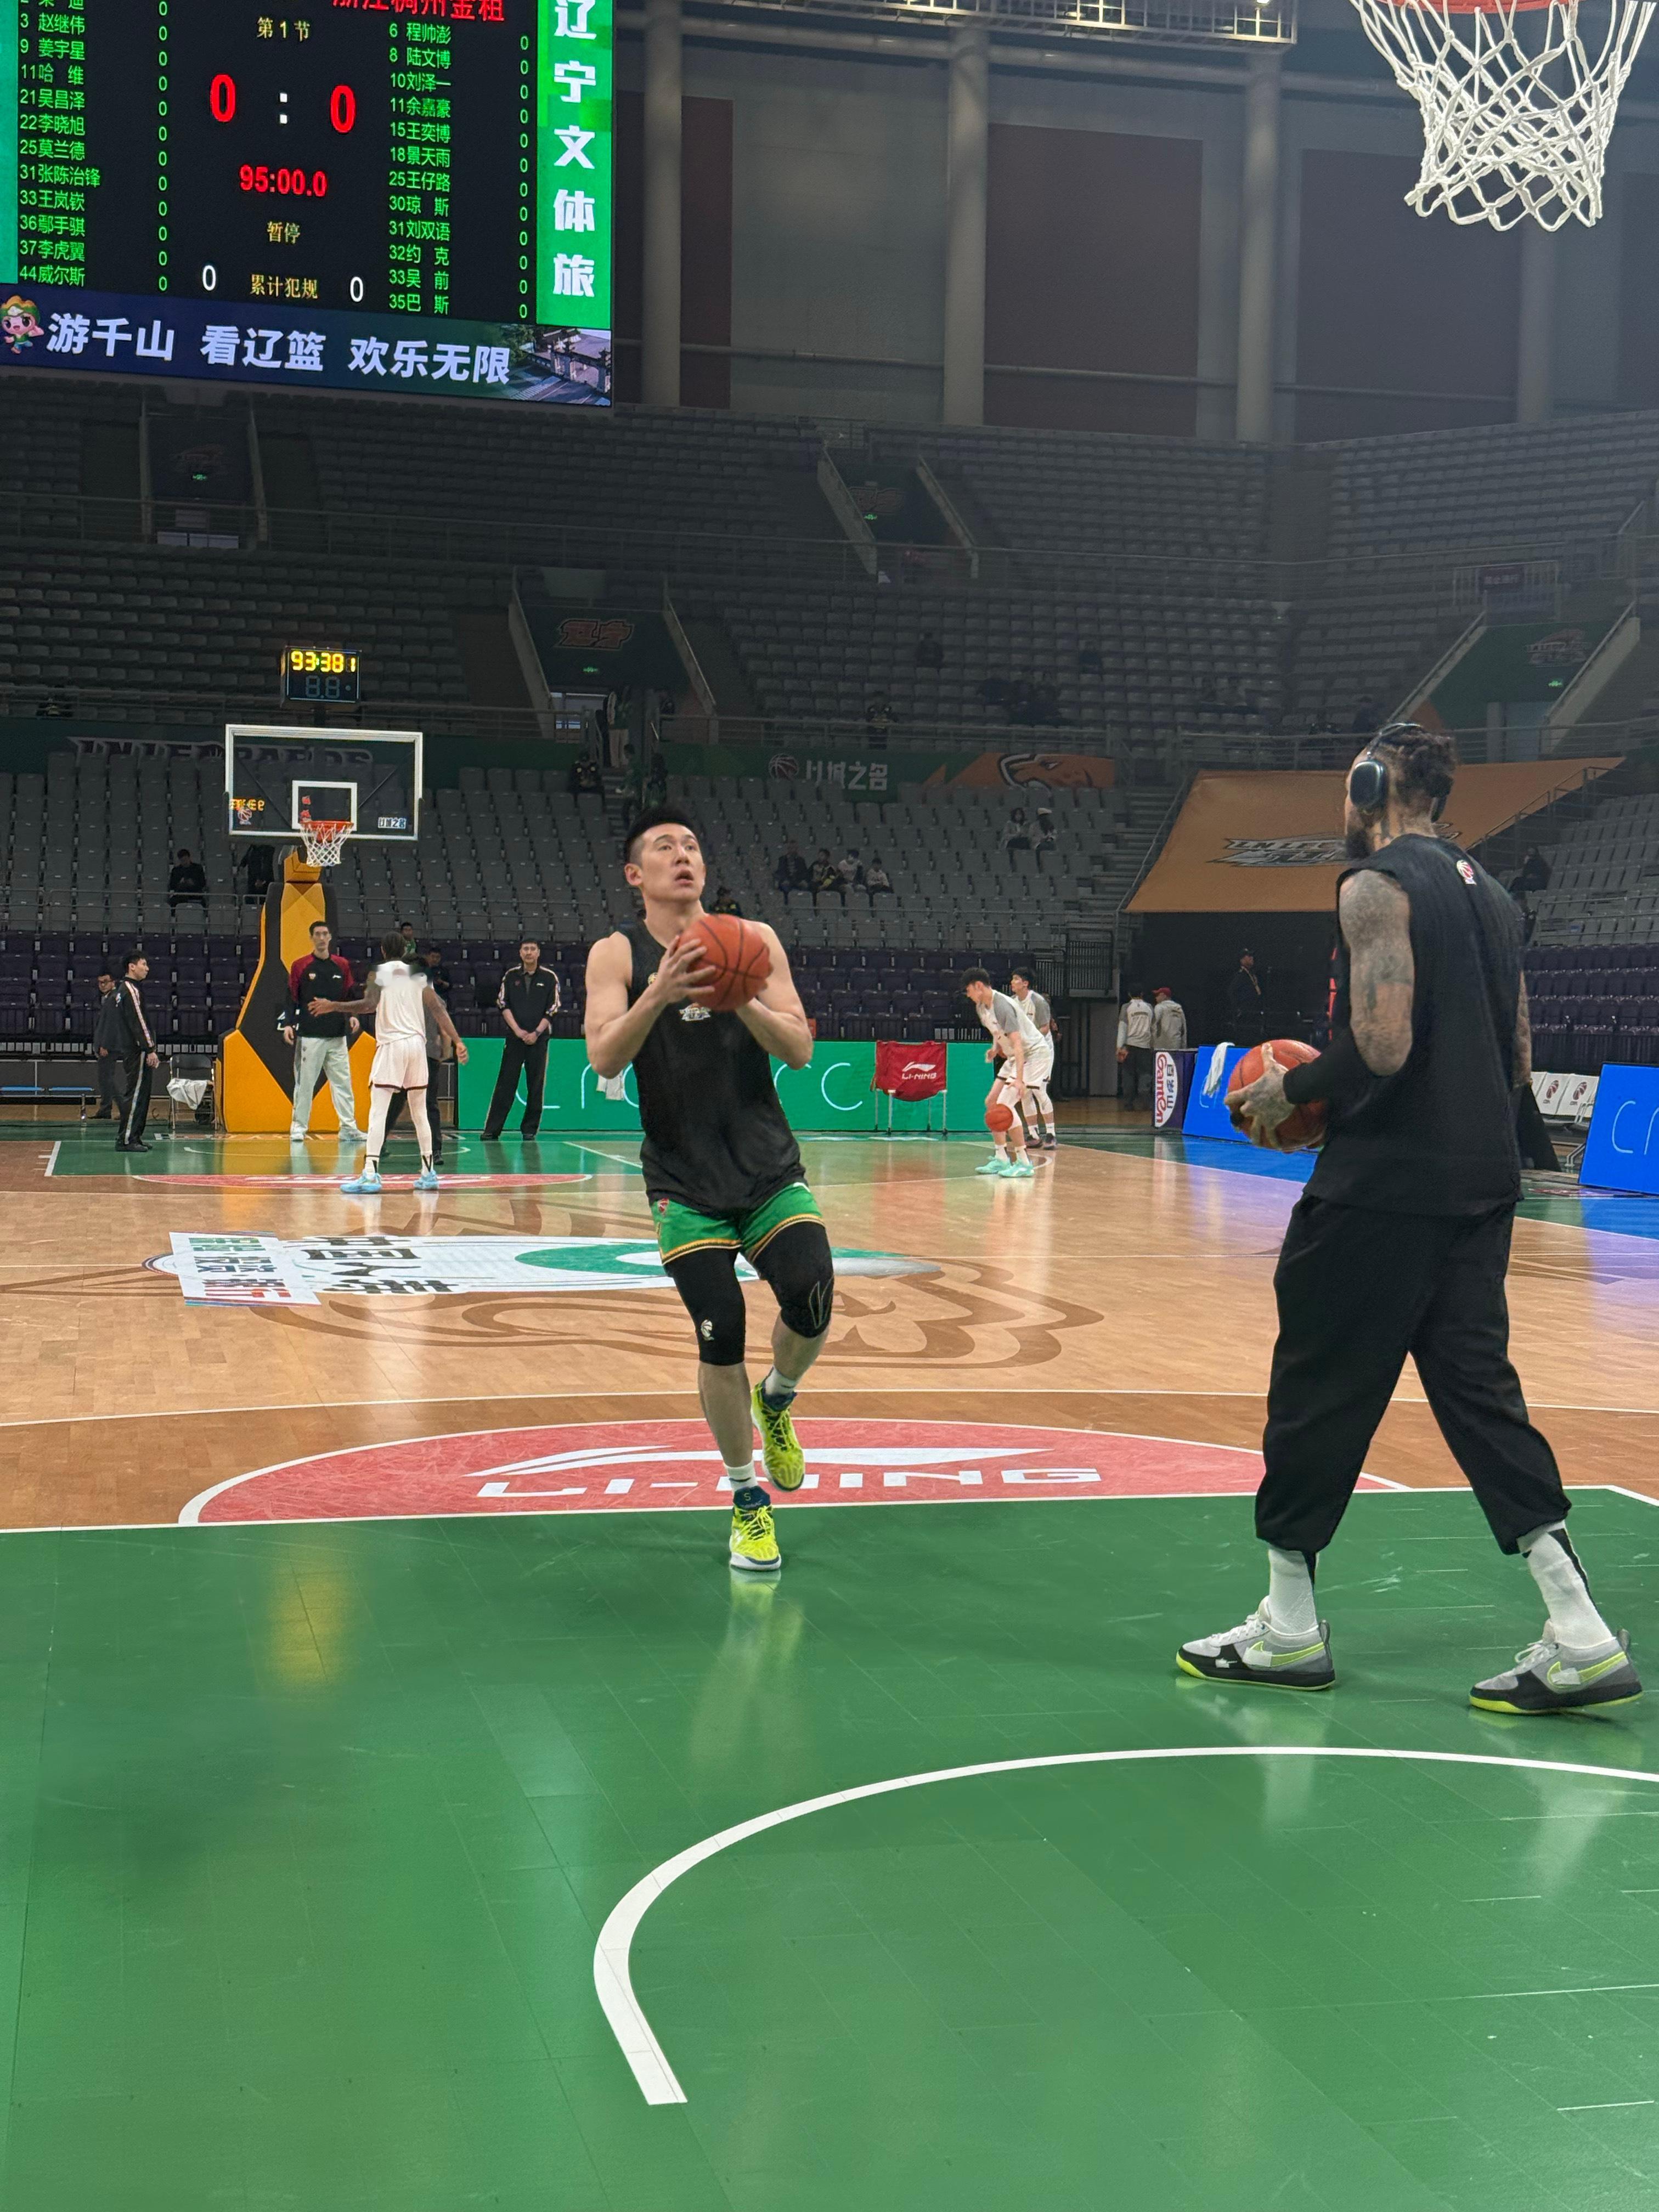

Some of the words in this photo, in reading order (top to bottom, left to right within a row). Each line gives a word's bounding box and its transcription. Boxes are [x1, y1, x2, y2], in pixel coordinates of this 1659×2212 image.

[159, 26, 167, 41] 0
[521, 36, 528, 50] 0
[159, 52, 167, 66] 0
[521, 60, 528, 74] 0
[159, 76, 167, 91] 0
[521, 85, 528, 99] 0
[159, 101, 167, 116] 0
[210, 75, 236, 122] 0
[330, 85, 356, 133] 0
[520, 109, 528, 123] 0
[159, 126, 167, 141] 0
[520, 133, 528, 148] 0
[554, 0, 597, 297] 辽宁文体旅
[159, 151, 167, 166] 0
[520, 158, 528, 172] 0
[159, 176, 167, 190] 0
[240, 165, 327, 196] 95:00.0
[520, 183, 527, 196] 0
[159, 201, 167, 216] 0
[520, 207, 527, 221] 0
[159, 227, 167, 241] 0
[267, 222, 300, 244] 暂停
[520, 232, 527, 245] 0
[159, 251, 167, 266] 0
[520, 256, 527, 269] 0
[159, 276, 167, 291] 0
[202, 265, 216, 291] 0
[251, 274, 318, 299] 累计犯规
[350, 276, 363, 302] 0
[520, 280, 527, 294] 0
[520, 304, 527, 318] 0
[47, 313, 174, 360] 游千山
[201, 325, 326, 371] 看辽篮
[348, 336, 510, 385] 欢乐无限
[291, 650, 344, 673] 93:38
